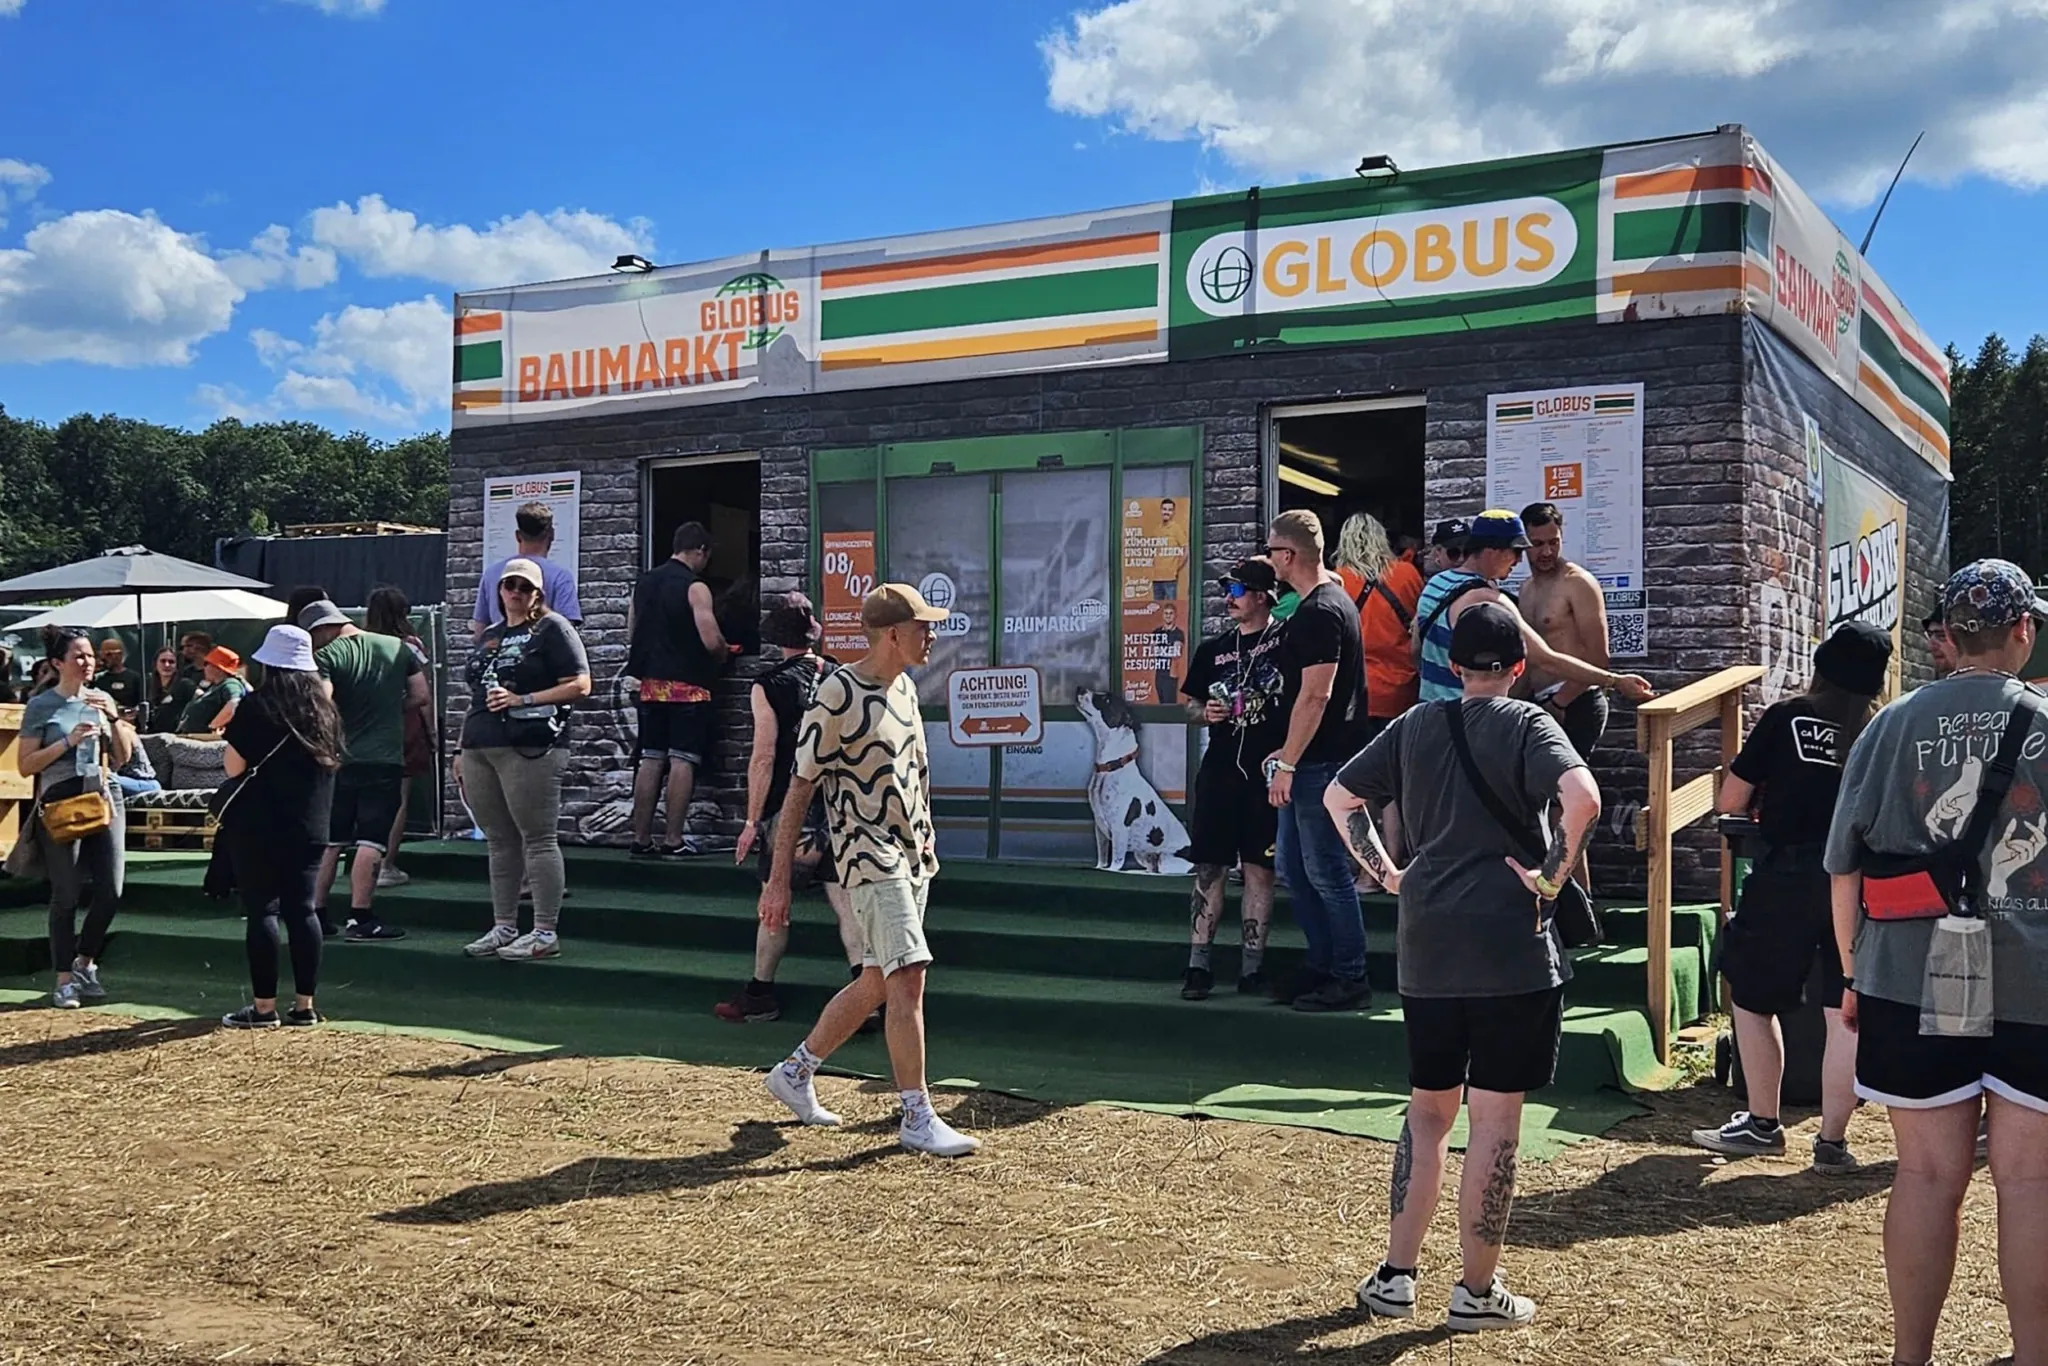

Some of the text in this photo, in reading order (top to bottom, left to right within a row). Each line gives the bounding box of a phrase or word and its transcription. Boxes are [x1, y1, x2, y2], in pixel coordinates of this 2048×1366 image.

[1262, 212, 1555, 298] GLOBUS
[700, 289, 799, 332] GLOBUS
[518, 331, 747, 403] BAUMARKT
[1536, 396, 1592, 416] GLOBUS
[514, 481, 549, 496] GLOBUS
[1124, 527, 1143, 537] WIR
[1071, 602, 1108, 616] GLOBUS
[1004, 616, 1088, 633] BAUMARKT
[1124, 633, 1169, 645] MEISTER
[1124, 646, 1181, 657] IM FLEXEN
[1124, 658, 1171, 670] GESUCHT!
[960, 675, 1028, 692] ACHTUNG!
[961, 702, 973, 710] DEN
[1005, 746, 1044, 755] EINGANG
